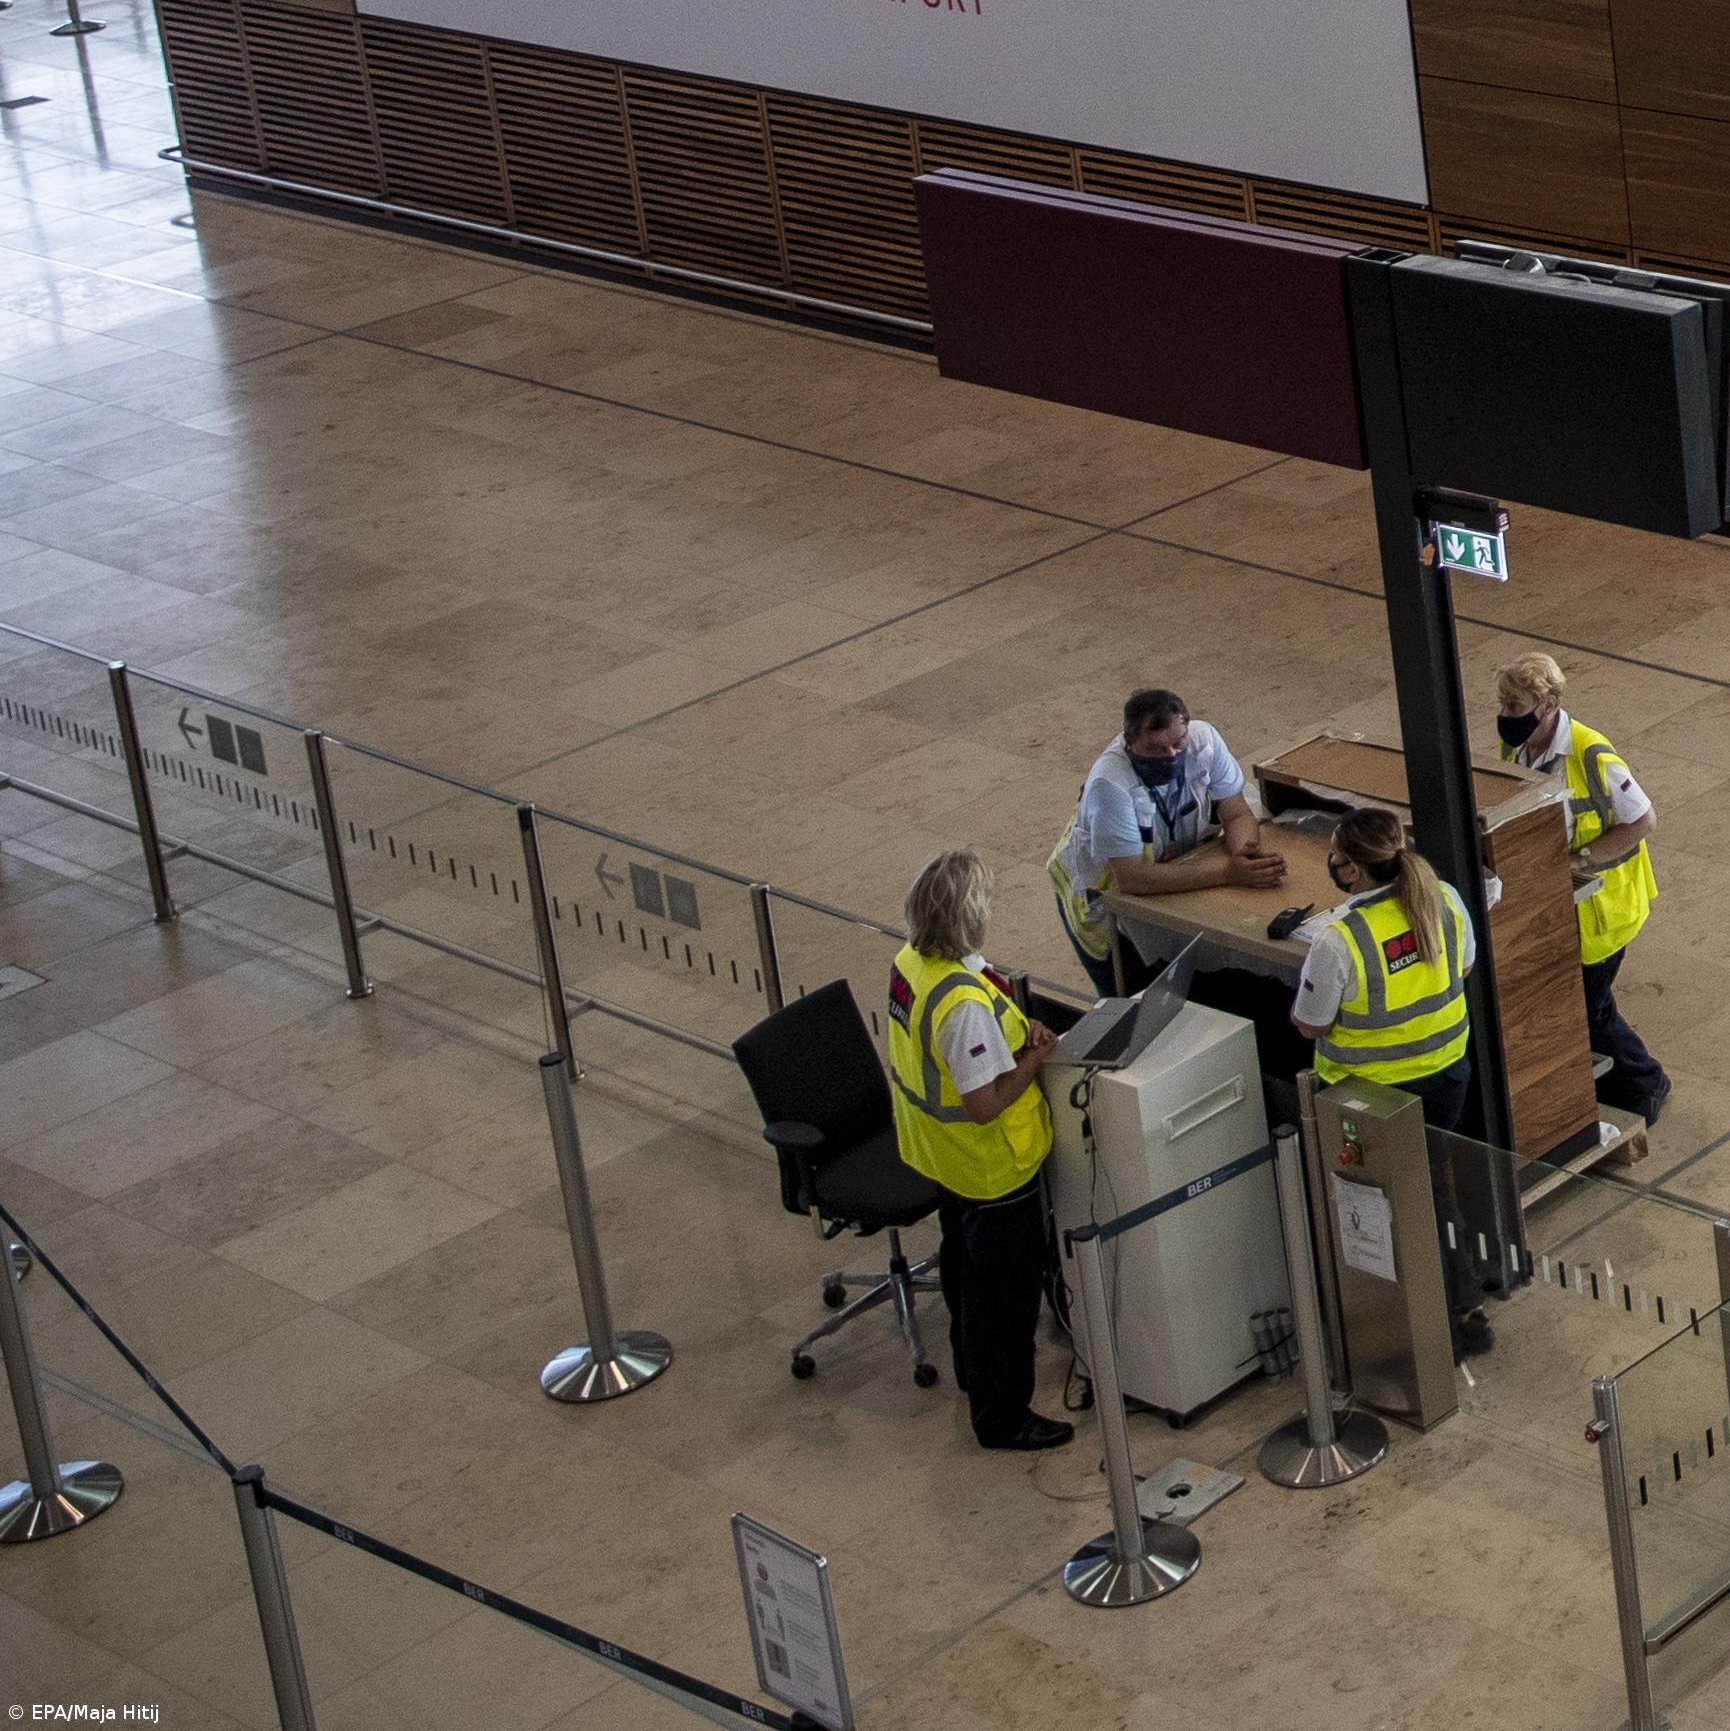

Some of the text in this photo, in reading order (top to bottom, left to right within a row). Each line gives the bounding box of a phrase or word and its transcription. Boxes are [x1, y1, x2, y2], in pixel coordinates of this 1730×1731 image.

[1389, 951, 1420, 972] SECUR
[1187, 1176, 1213, 1198] BER
[333, 1524, 355, 1543] BER
[463, 1582, 487, 1602] BER
[599, 1641, 623, 1661] BER
[741, 1701, 766, 1722] BER
